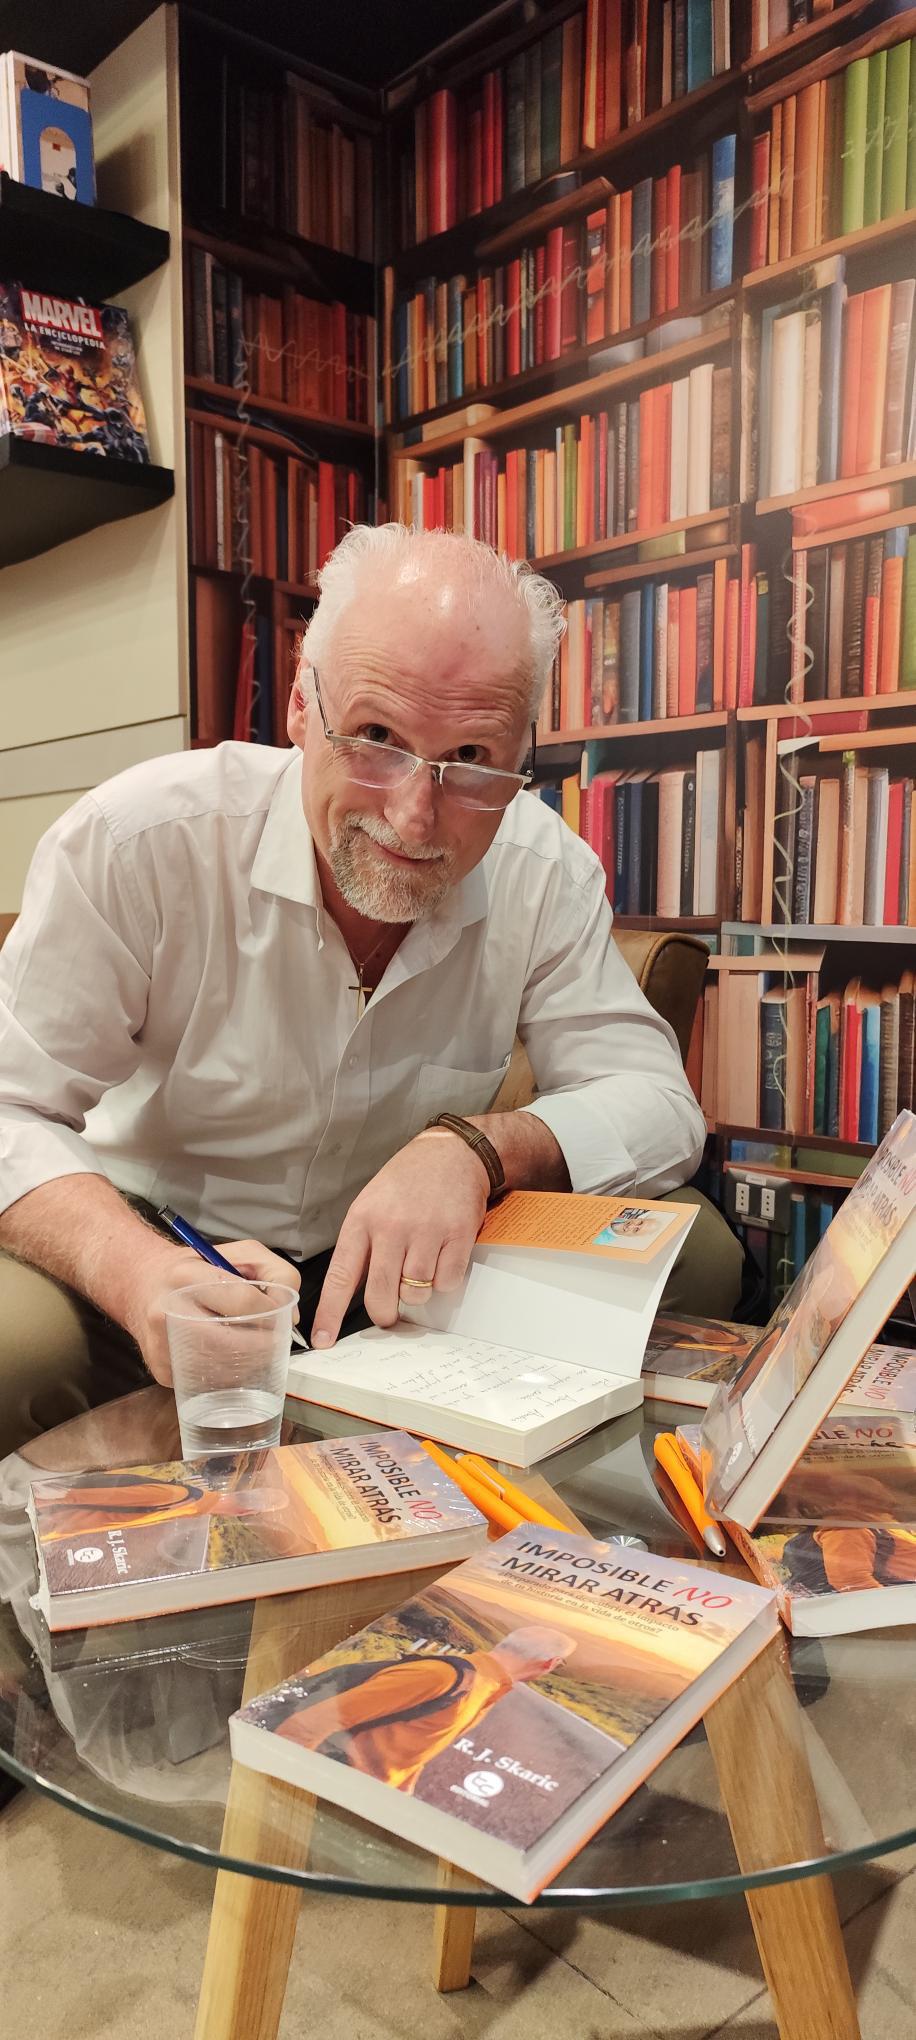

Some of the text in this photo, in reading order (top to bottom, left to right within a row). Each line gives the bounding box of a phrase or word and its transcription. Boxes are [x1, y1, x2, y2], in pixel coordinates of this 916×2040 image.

[21, 291, 102, 337] MARVEL
[24, 322, 37, 333] LA
[39, 326, 106, 350] ENCICLOPEDIA
[864, 1351, 913, 1400] IMPOSIBLE NO
[856, 1427, 893, 1438] NO
[330, 1447, 372, 1483] MIRAR
[356, 1485, 402, 1523] ATRÁS
[360, 1441, 442, 1519] IMPOSIBLE NO
[501, 1556, 704, 1626] MIRAR ATRÁS
[516, 1541, 733, 1609] IMPOSIBLE NO
[526, 1586, 565, 1601] historia
[565, 1599, 578, 1607] en
[590, 1607, 612, 1618] vida
[613, 1613, 627, 1622] de
[636, 1613, 680, 1632] impacto
[452, 1737, 560, 1792] R. J. Skaric
